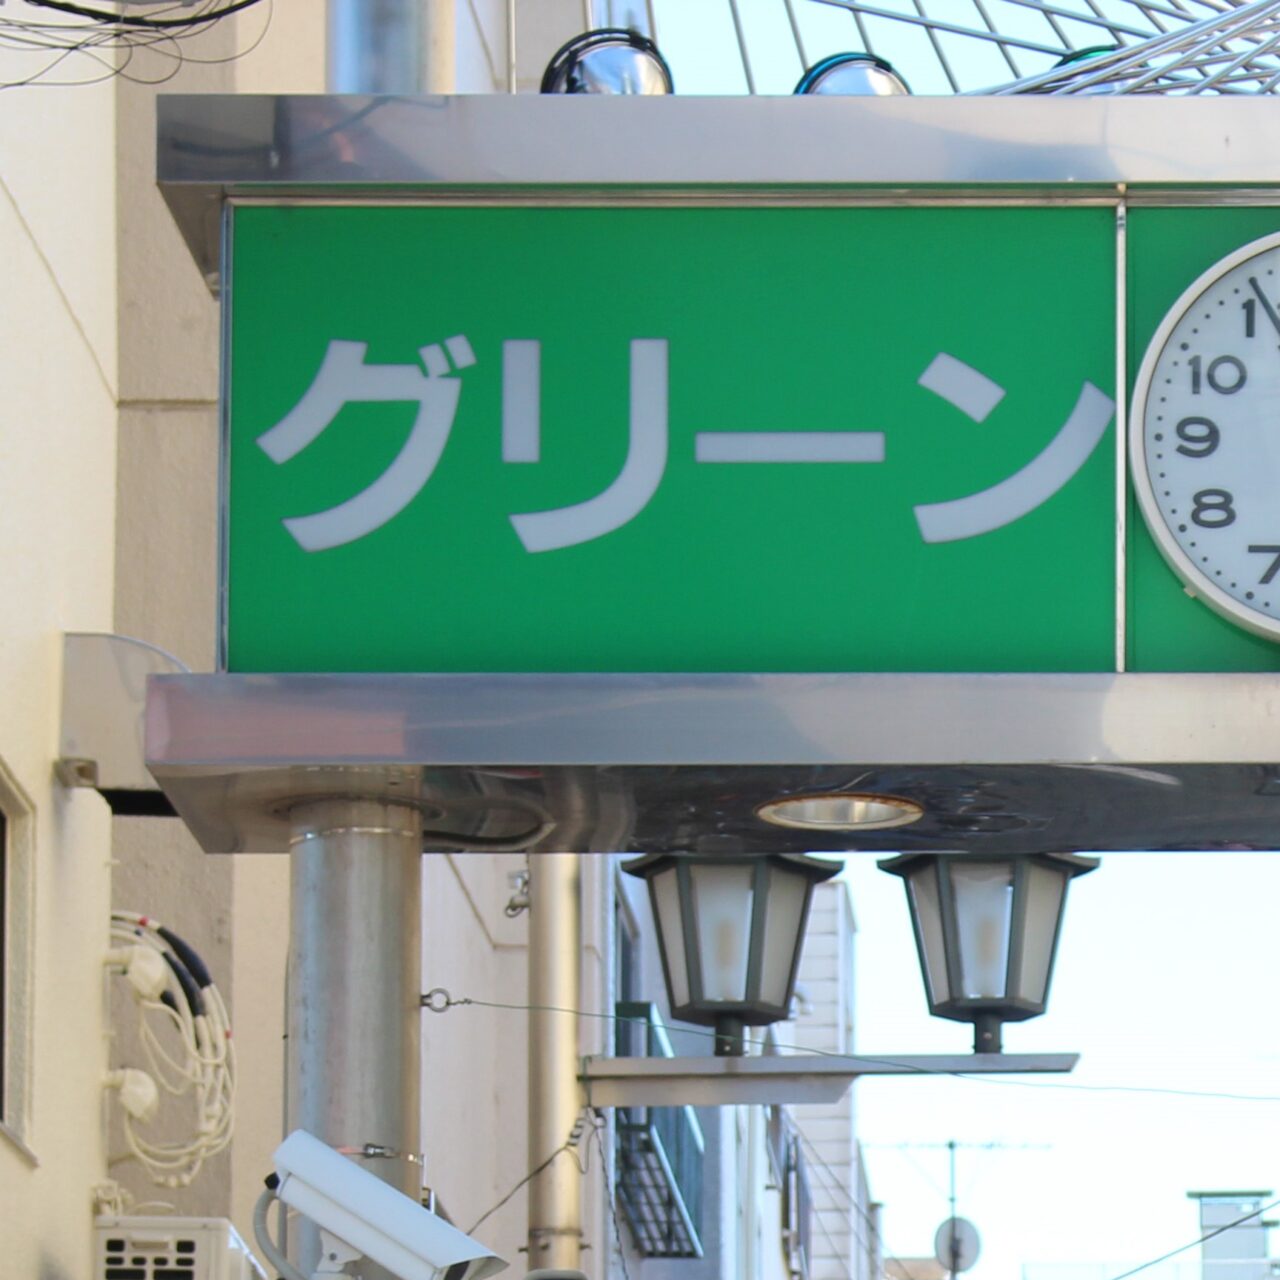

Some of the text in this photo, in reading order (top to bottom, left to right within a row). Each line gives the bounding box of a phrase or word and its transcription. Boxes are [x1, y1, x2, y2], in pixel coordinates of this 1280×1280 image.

[1188, 355, 1247, 395] 10
[256, 334, 1115, 553] グリーン
[1175, 416, 1220, 458] 9
[1191, 489, 1236, 528] 8
